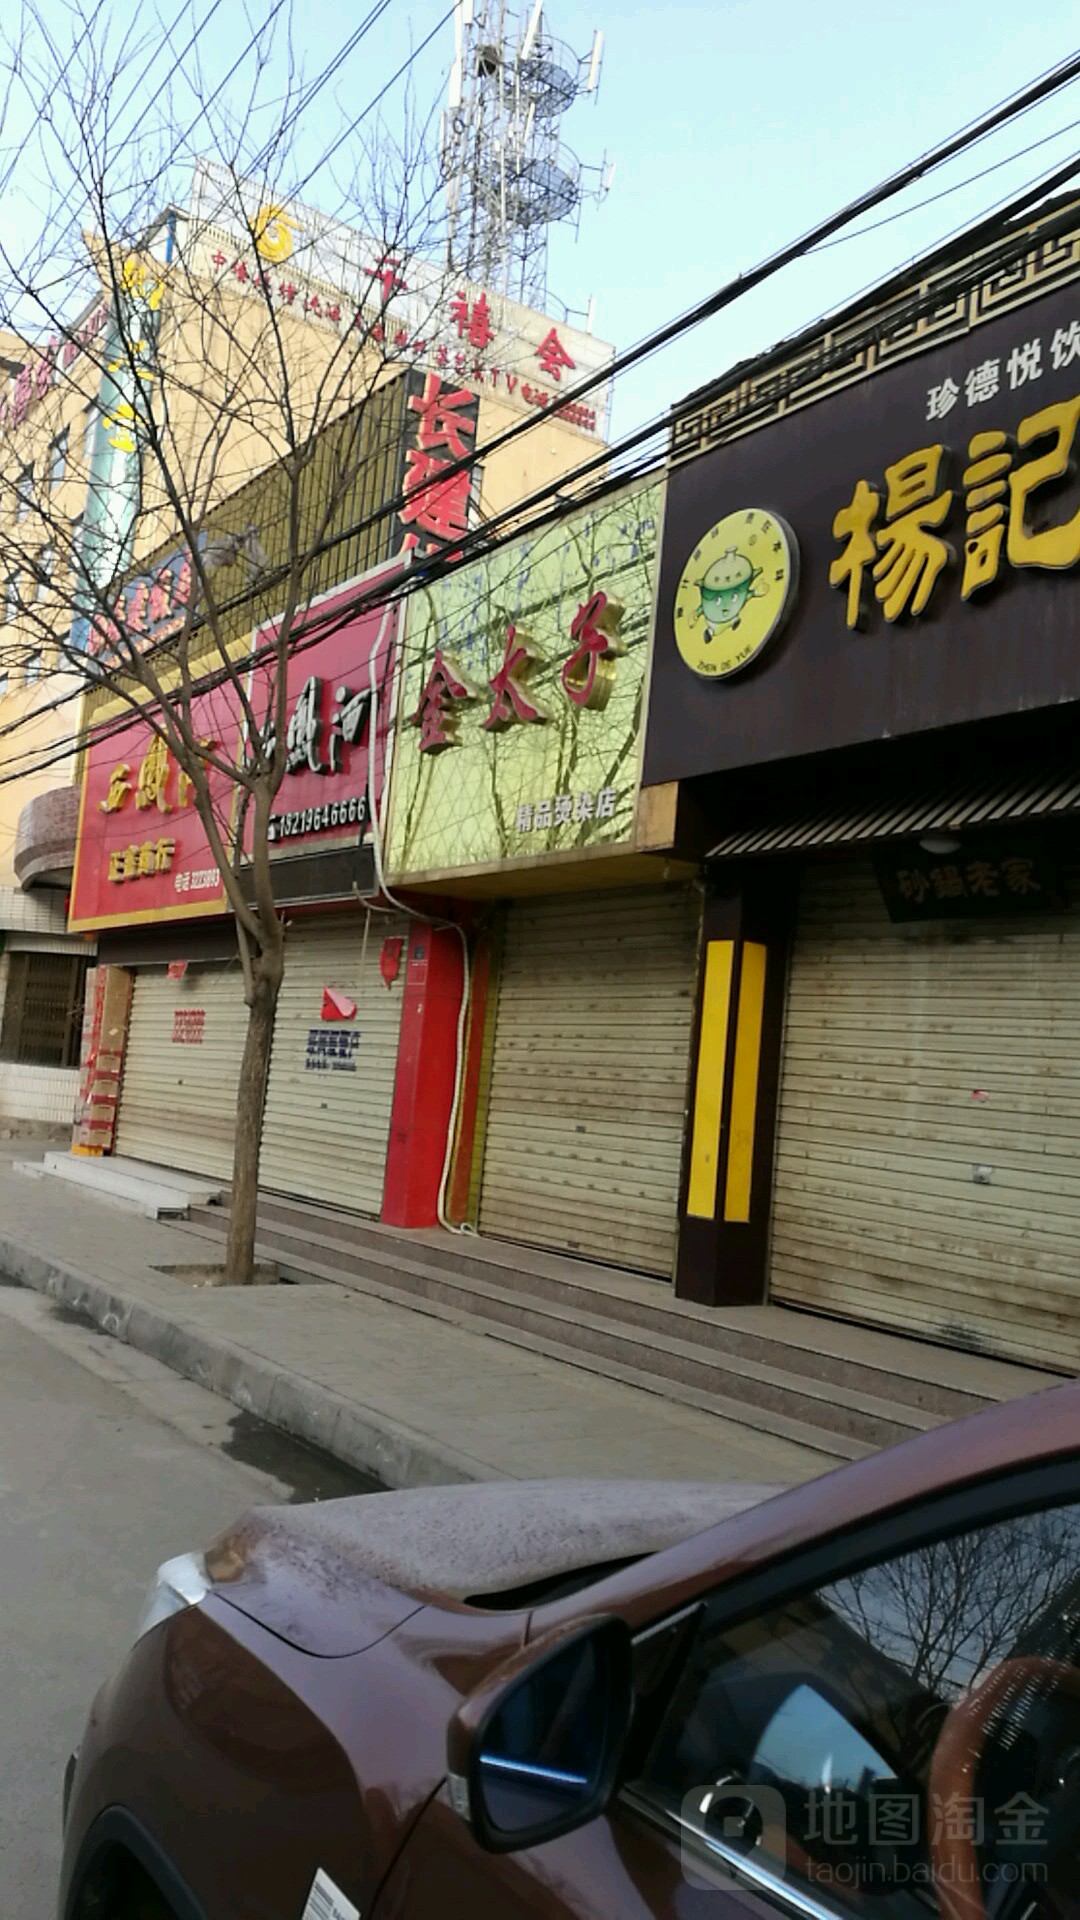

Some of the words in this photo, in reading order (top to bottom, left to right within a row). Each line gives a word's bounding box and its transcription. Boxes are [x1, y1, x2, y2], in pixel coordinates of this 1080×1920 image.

[411, 591, 618, 753] 金太子
[514, 786, 618, 834] 精品烫染店
